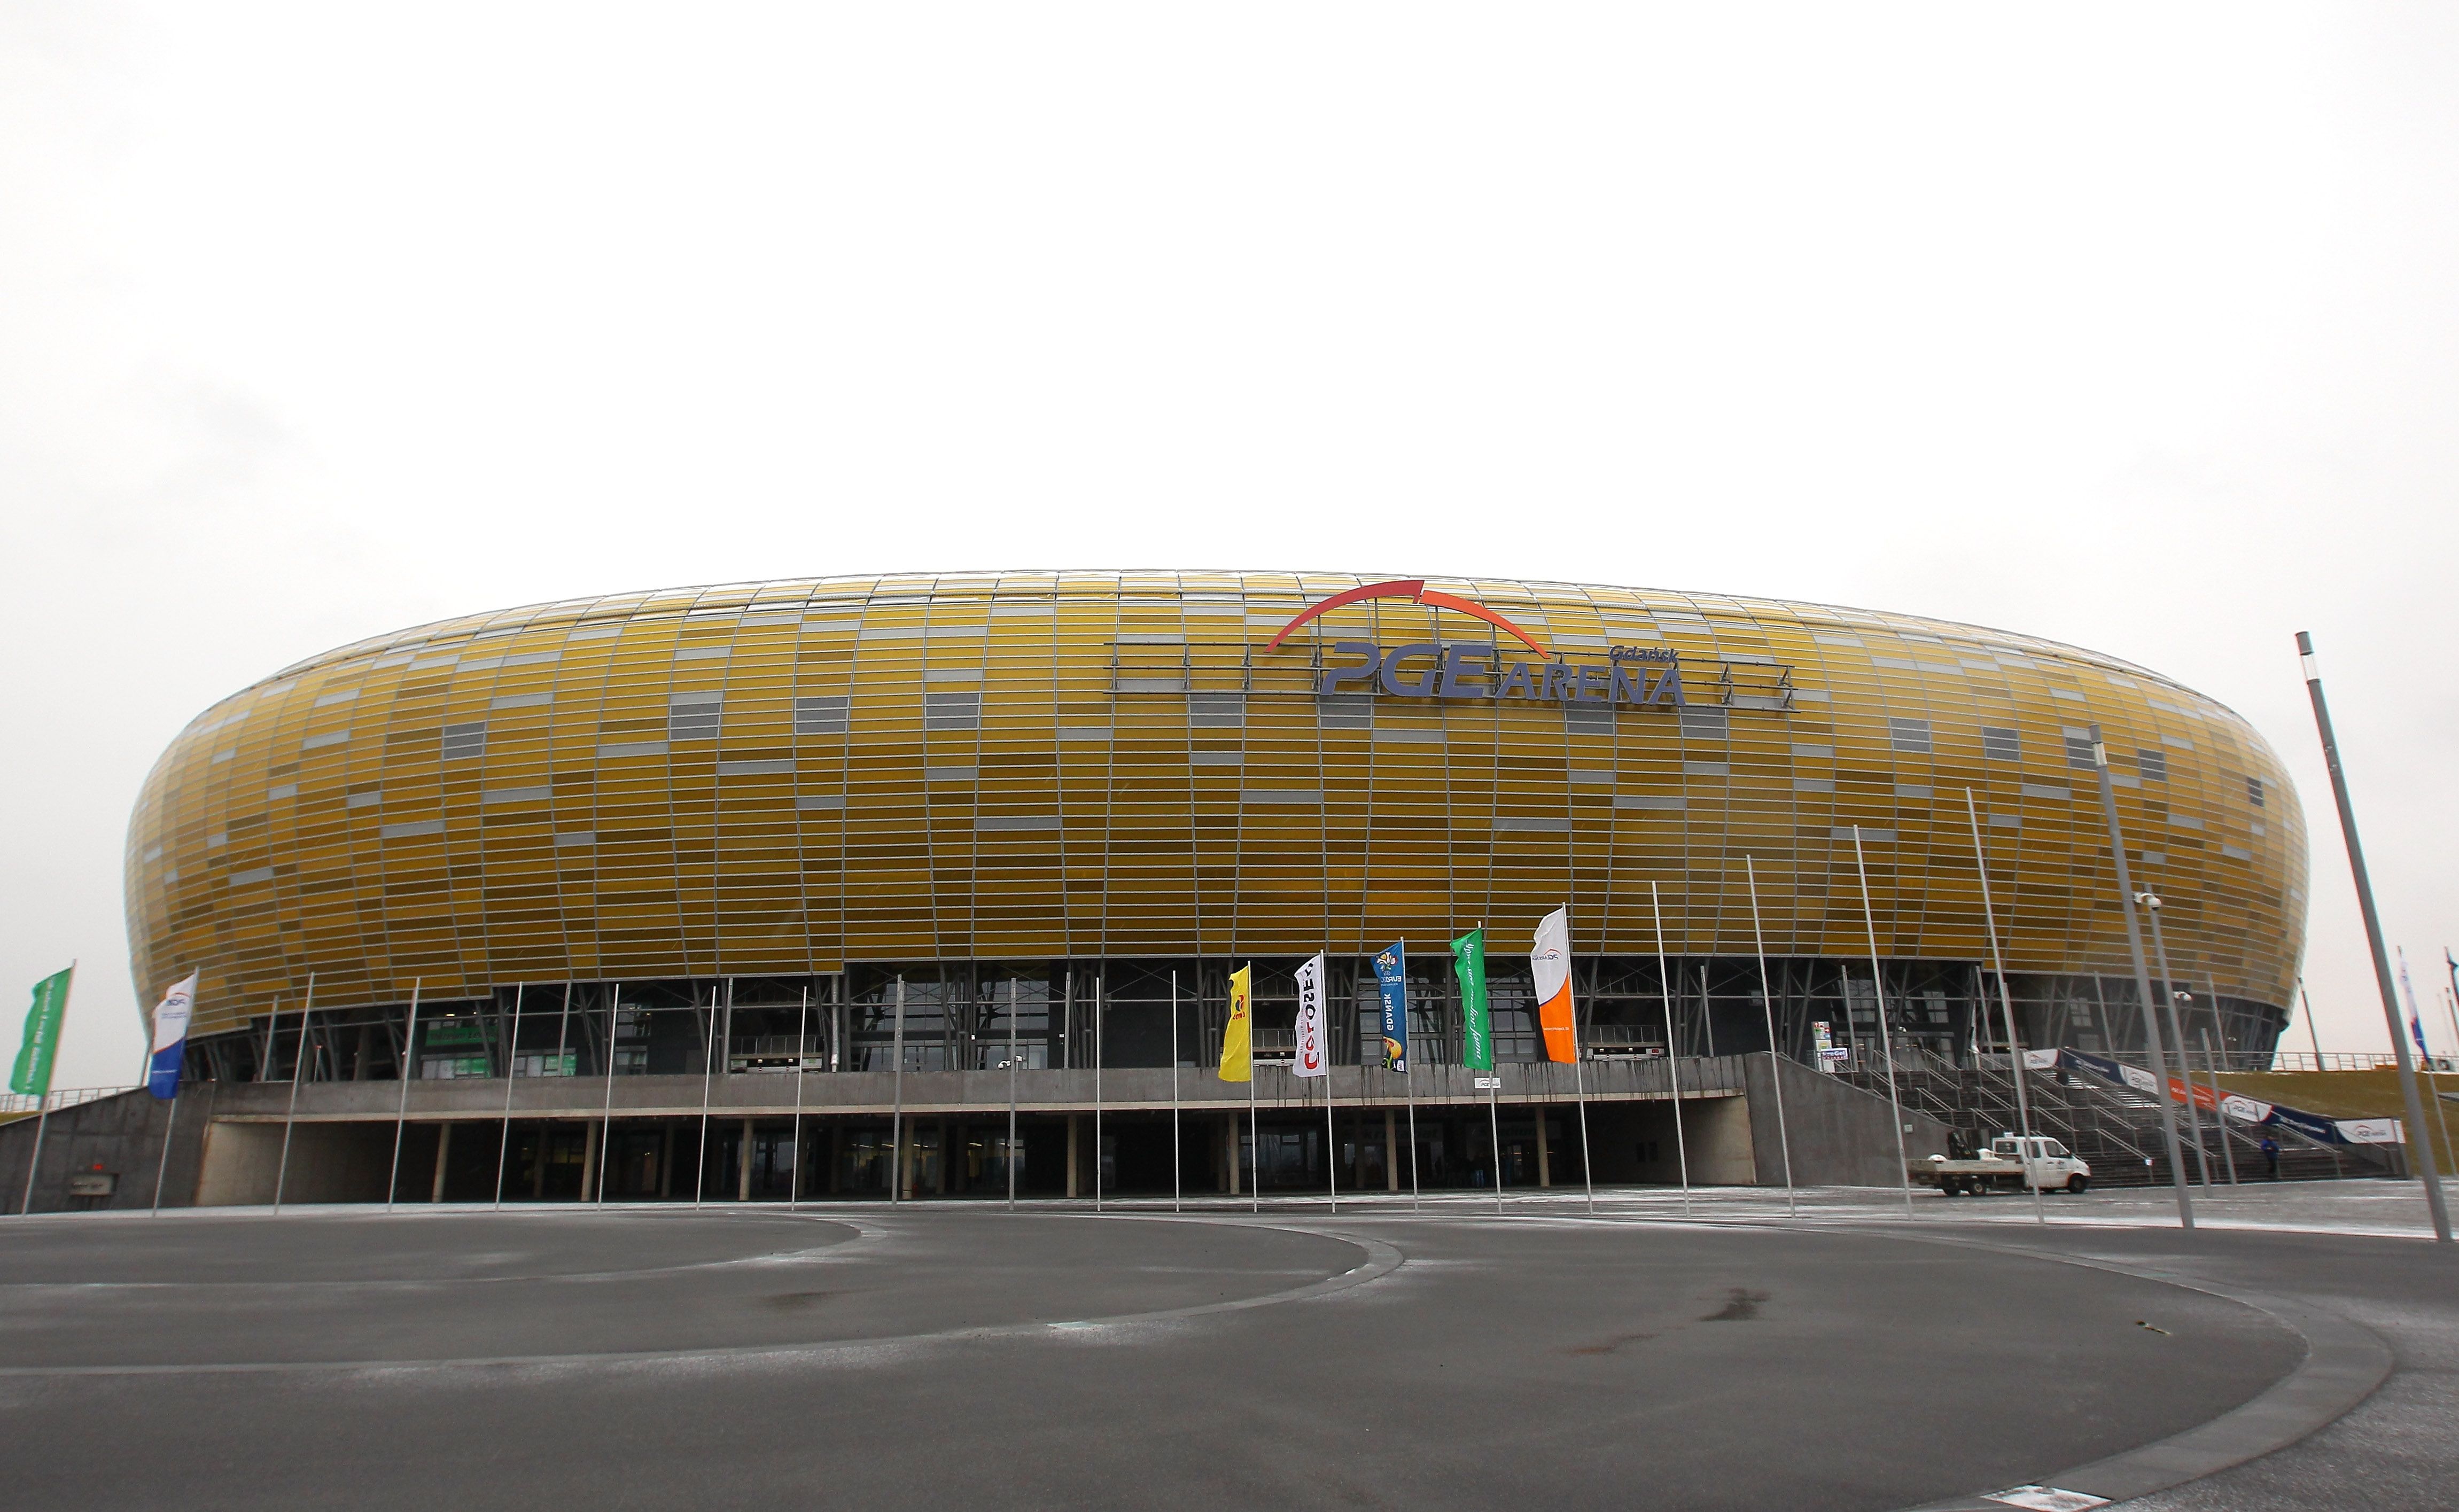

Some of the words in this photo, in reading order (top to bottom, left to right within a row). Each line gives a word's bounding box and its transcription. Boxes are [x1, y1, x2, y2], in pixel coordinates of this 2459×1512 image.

[1320, 642, 1493, 698] PGE
[1495, 663, 1686, 706] ARENA
[1609, 645, 1679, 663] Gdańsk
